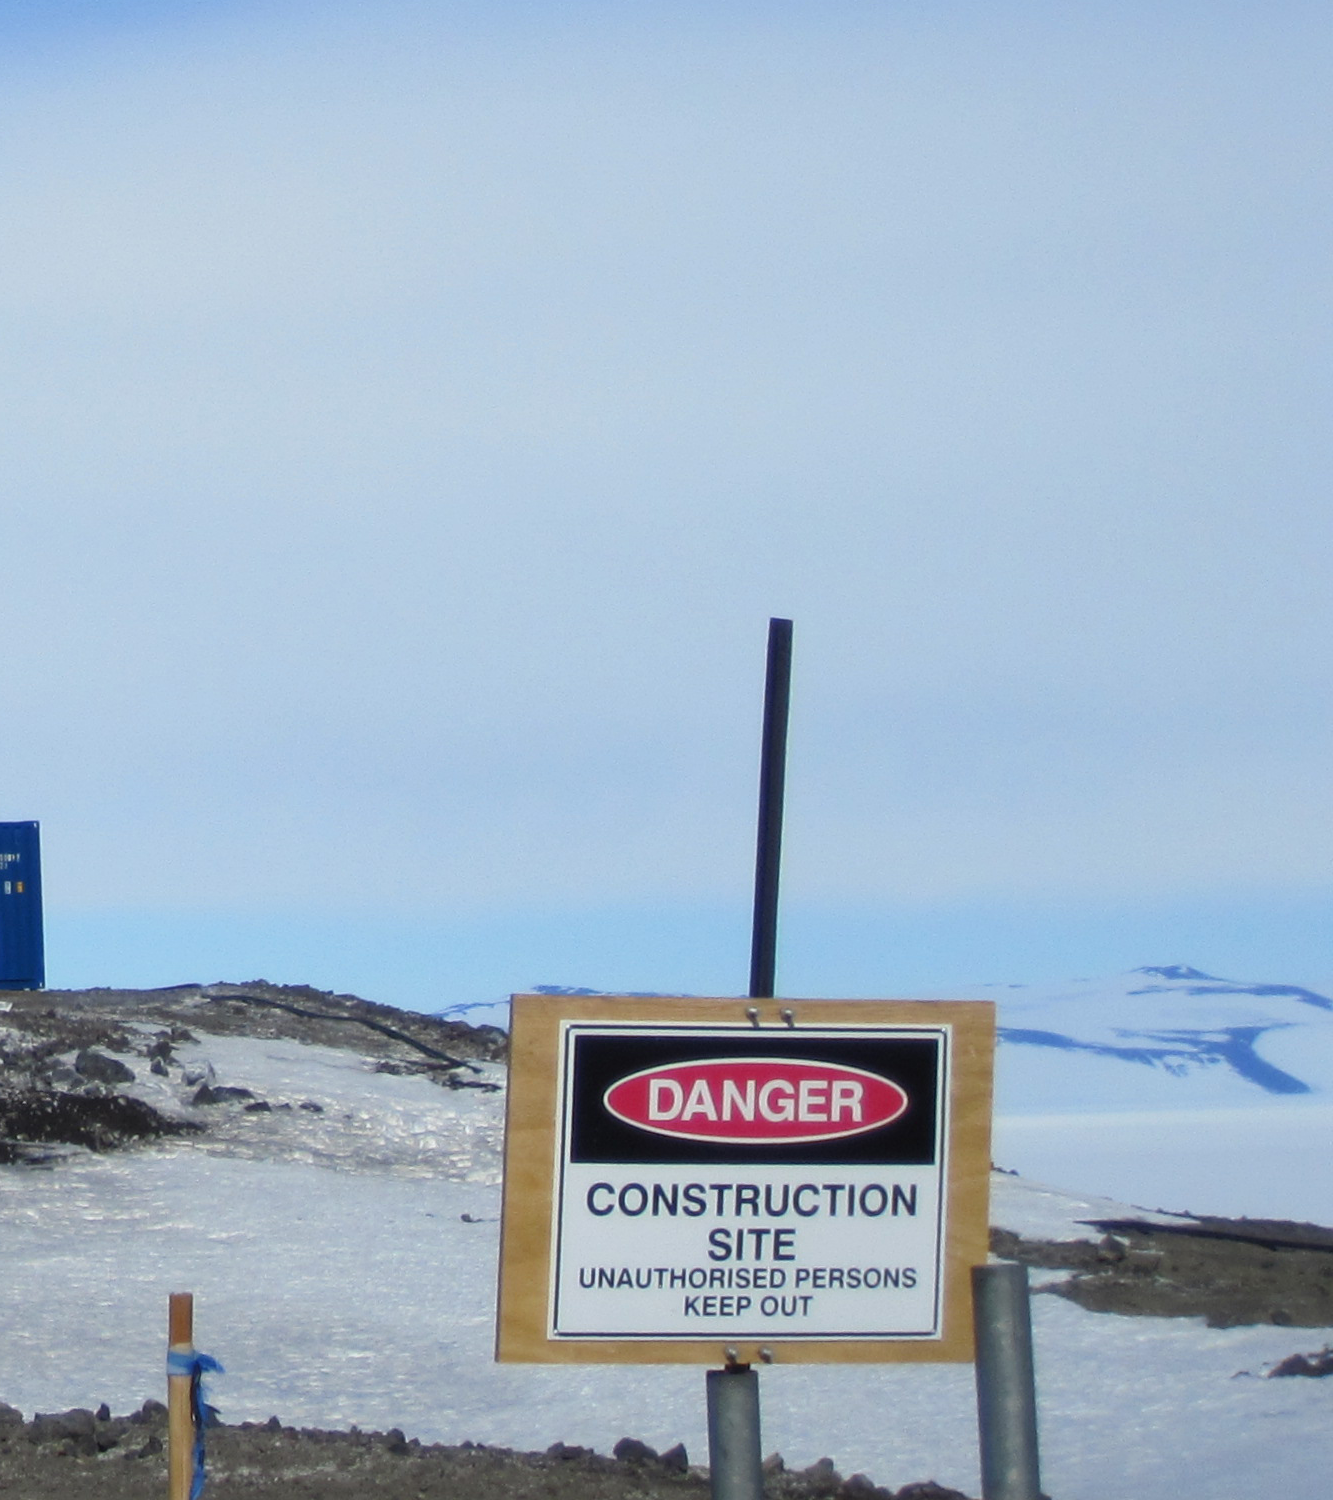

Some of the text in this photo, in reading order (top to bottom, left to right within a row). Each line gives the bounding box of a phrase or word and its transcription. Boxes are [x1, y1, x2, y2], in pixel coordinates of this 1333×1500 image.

[647, 1078, 864, 1123] DANGER
[586, 1182, 918, 1217] CONSTRUCTION
[707, 1227, 796, 1261] SITE
[579, 1267, 917, 1288] UNAUTHORISED PERSONS
[684, 1296, 814, 1317] KEEP OUT
